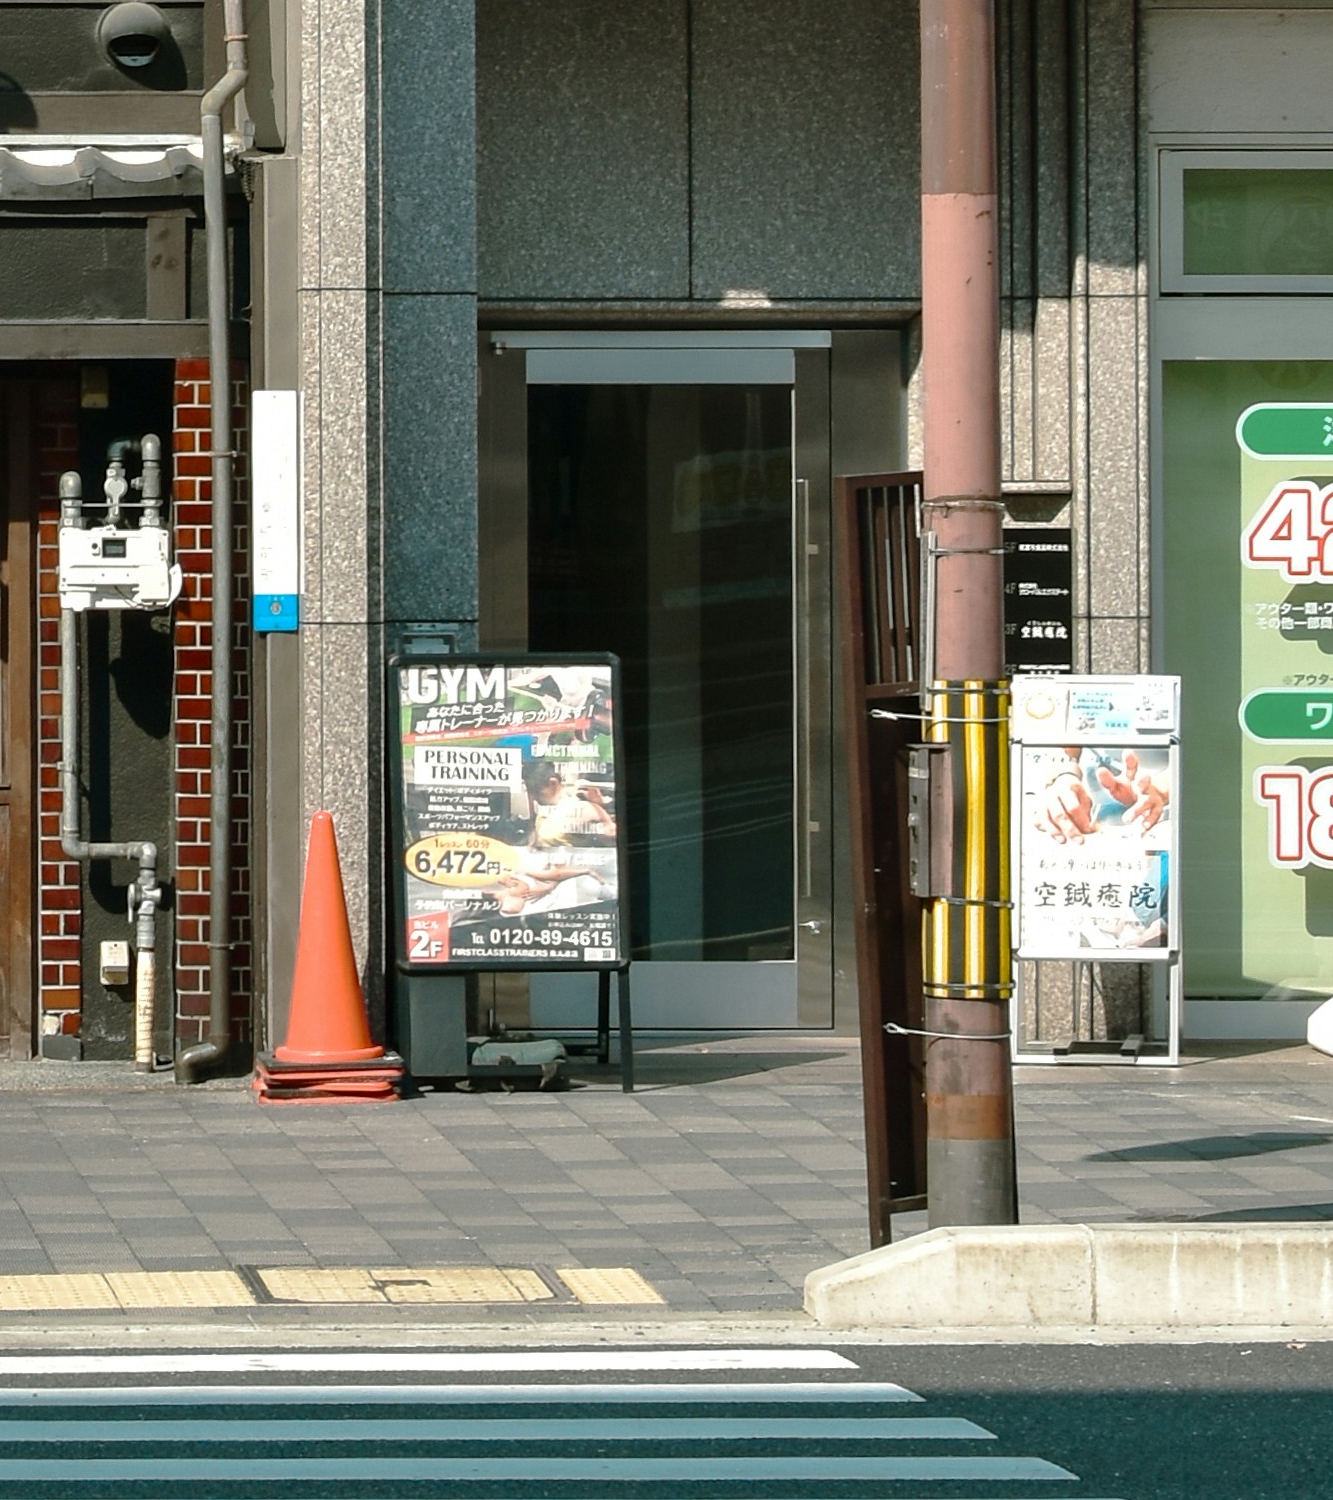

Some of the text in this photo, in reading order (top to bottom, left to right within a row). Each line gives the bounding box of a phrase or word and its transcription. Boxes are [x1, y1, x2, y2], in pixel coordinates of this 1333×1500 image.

[1249, 489, 1333, 575] 4
[408, 665, 505, 703] GYM
[425, 750, 513, 765] PERSONAL
[431, 766, 509, 781] TRAINING
[409, 929, 443, 957] 2F
[489, 927, 613, 947] 0120-89-4615
